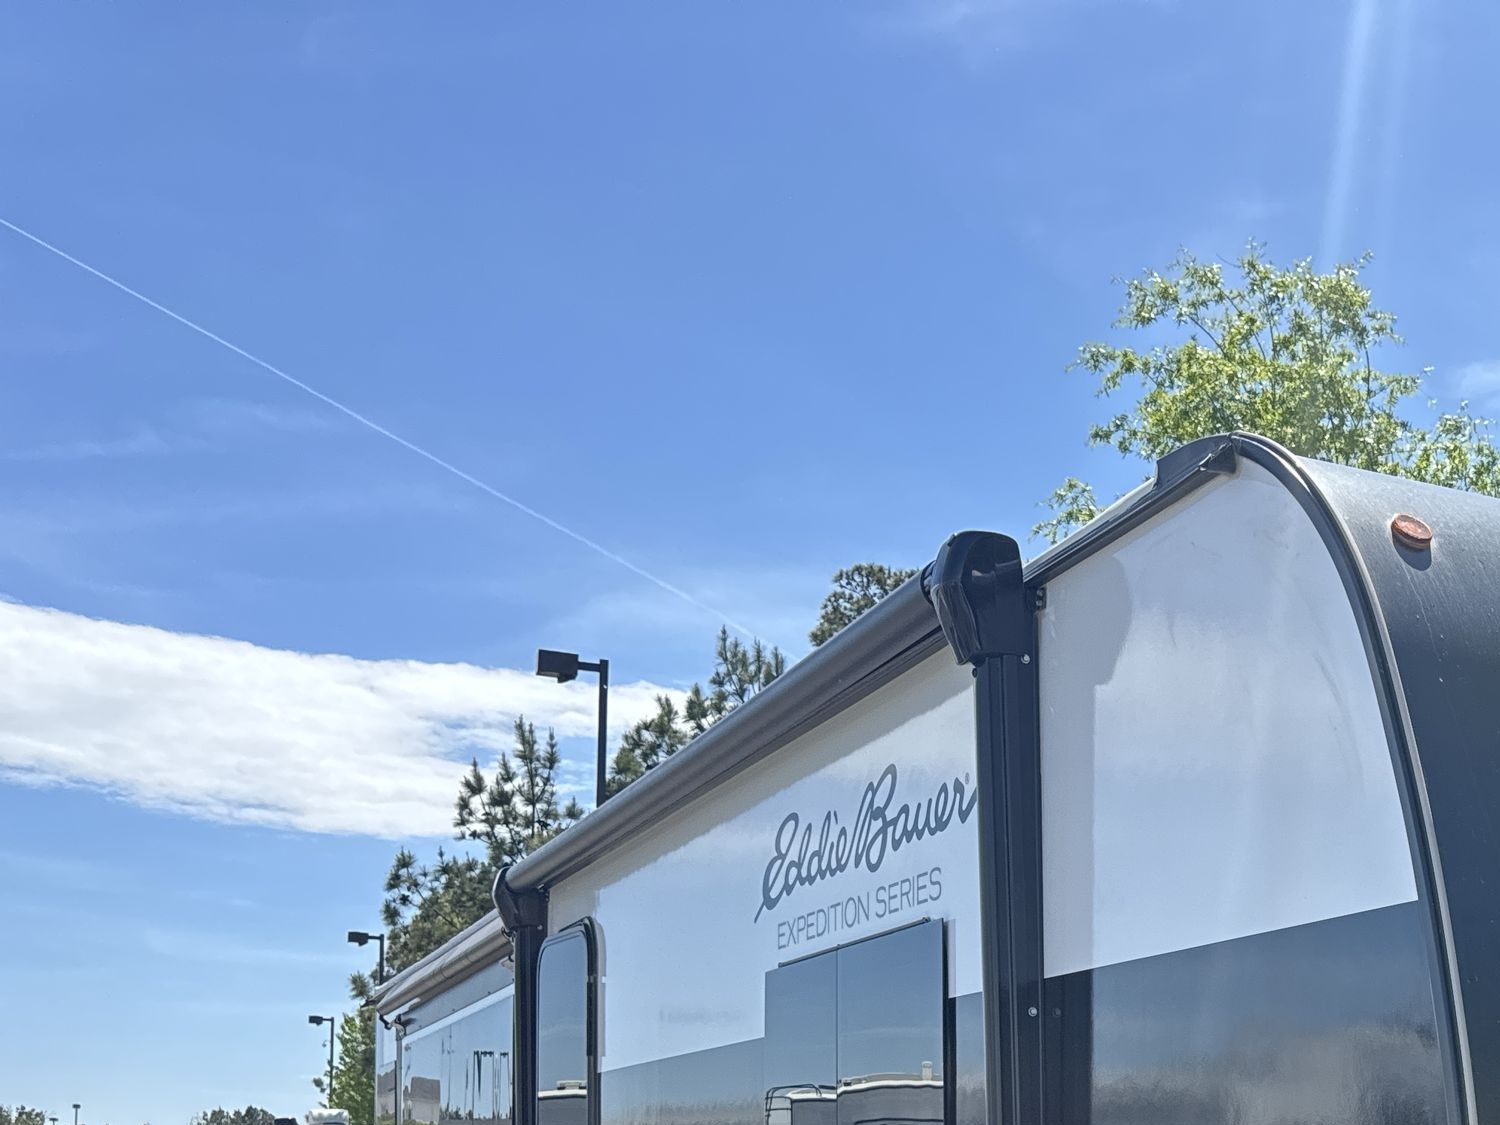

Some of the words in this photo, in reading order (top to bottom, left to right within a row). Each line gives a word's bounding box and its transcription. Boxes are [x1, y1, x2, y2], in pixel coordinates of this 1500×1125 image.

[755, 812, 849, 923] Eddie
[850, 763, 977, 873] Bauer
[777, 891, 870, 950] EXPEDITION
[875, 866, 942, 919] SERIES
